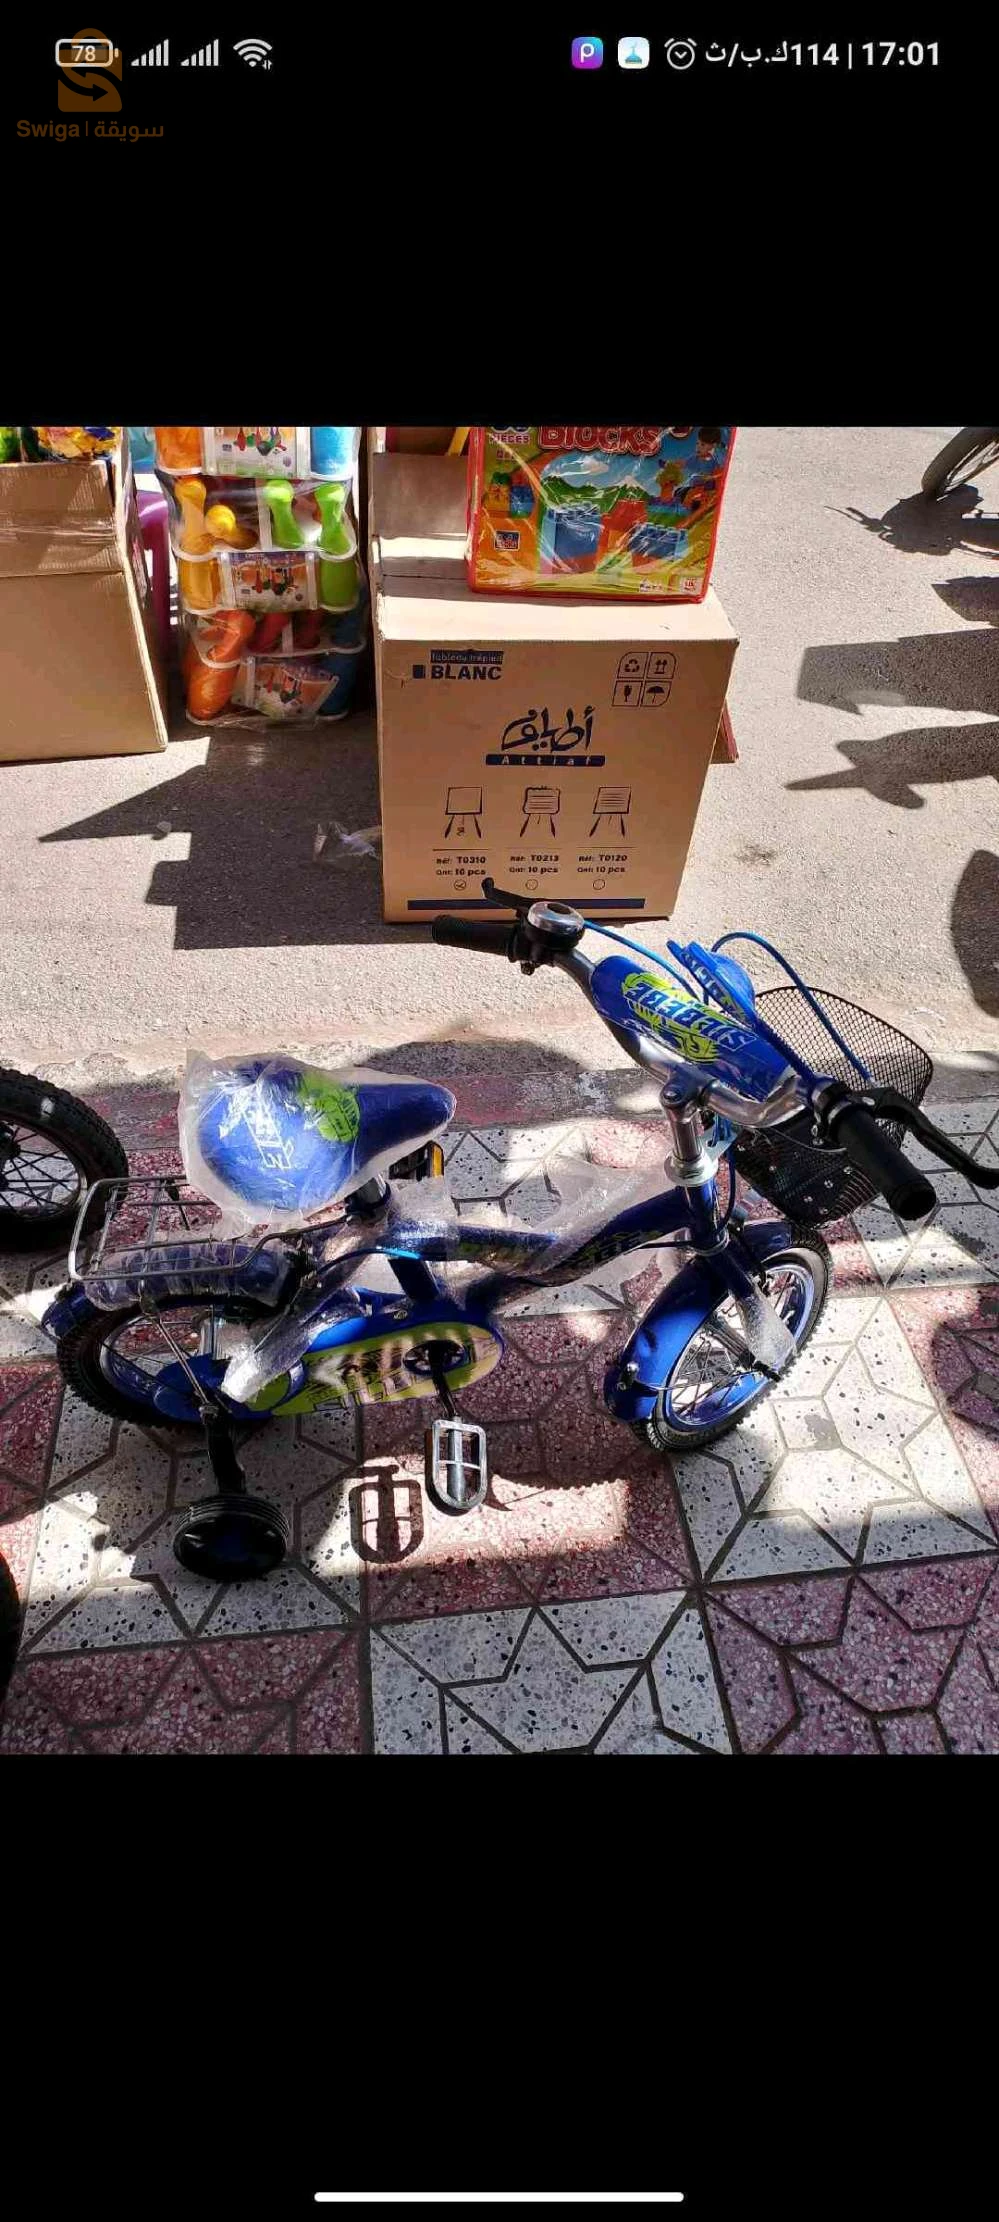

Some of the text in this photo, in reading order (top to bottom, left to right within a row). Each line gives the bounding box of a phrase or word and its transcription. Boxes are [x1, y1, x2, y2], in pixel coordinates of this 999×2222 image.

[431, 664, 502, 680] BLANC
[456, 856, 486, 864] T0310
[599, 854, 628, 862] T0120
[540, 867, 558, 875] pcs
[607, 867, 626, 875] pcs
